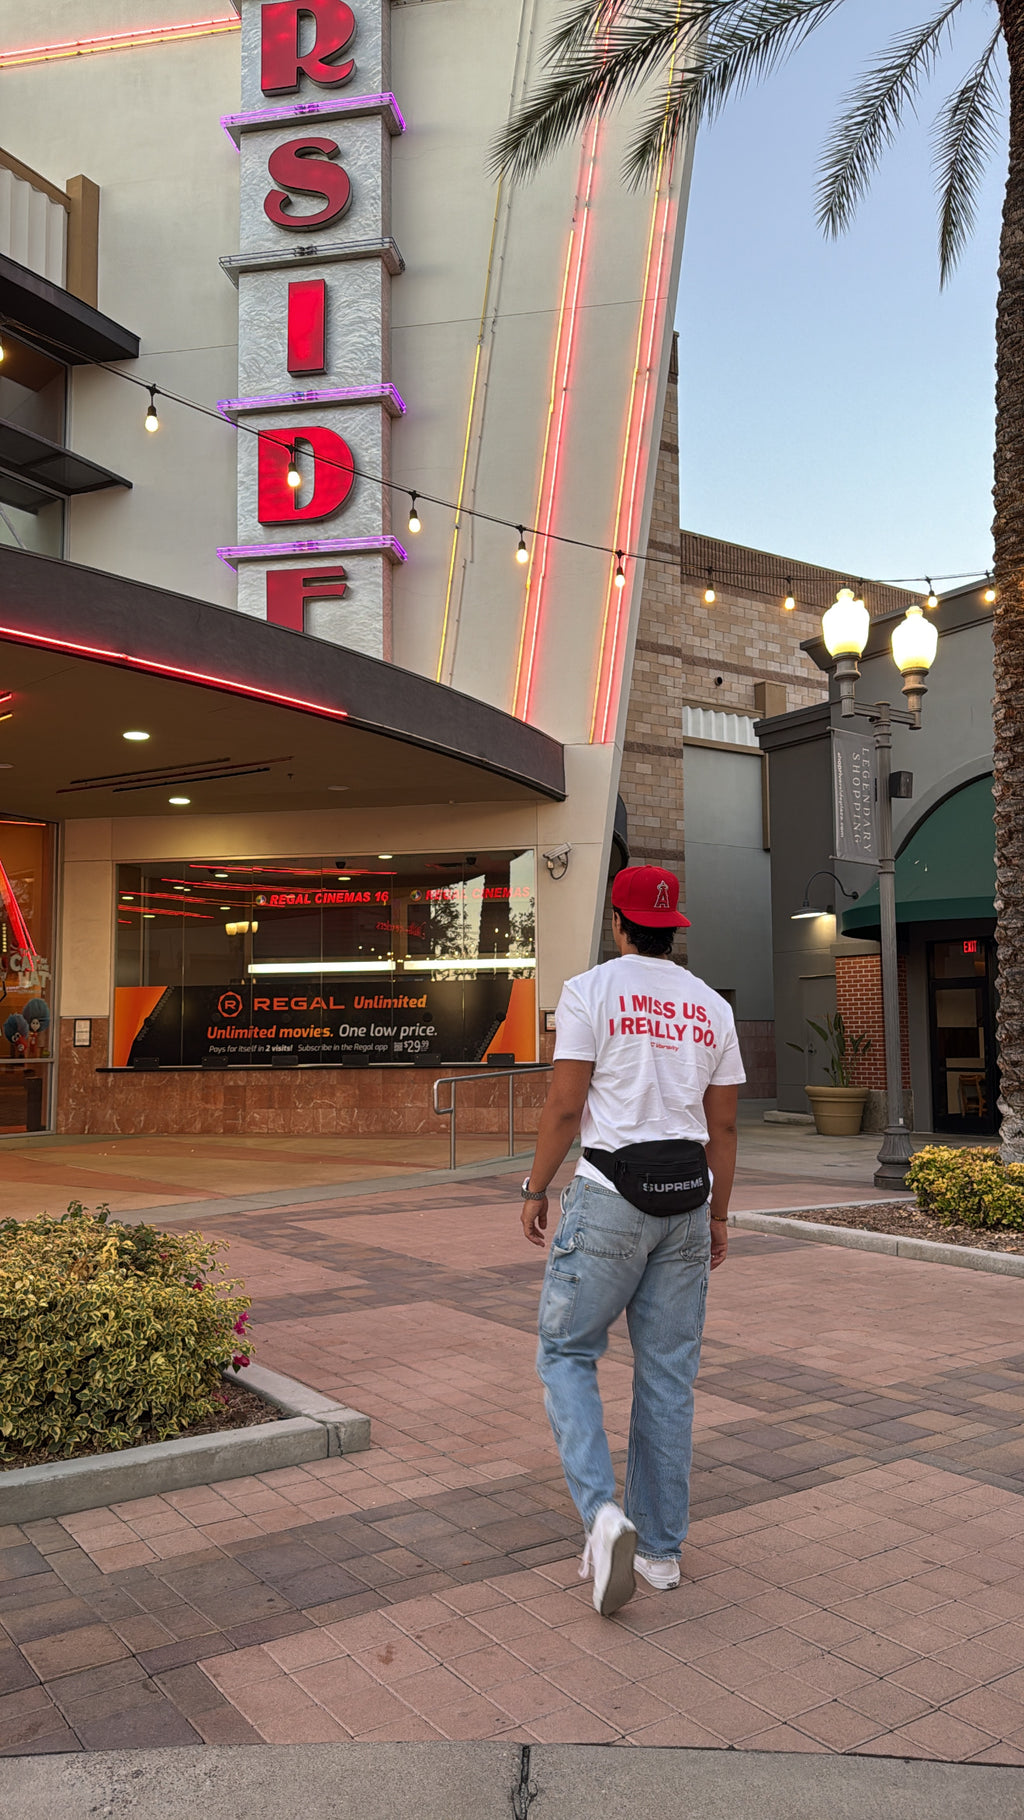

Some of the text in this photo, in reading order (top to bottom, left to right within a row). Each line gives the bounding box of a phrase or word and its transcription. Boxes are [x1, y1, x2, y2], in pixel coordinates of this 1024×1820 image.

[852, 752, 862, 843] SHOPPING
[861, 747, 872, 852] LEGENDARY
[270, 891, 389, 905] REGAL CINEMAS 16
[426, 886, 531, 901] REGAL CINEMAS
[963, 940, 977, 953] EXIT
[253, 996, 345, 1011] REGAL
[354, 994, 427, 1009] Unlimited
[619, 994, 712, 1028] I MISS US,
[207, 1022, 438, 1040] Unlimited movies. One low price.
[609, 1018, 615, 1036] I
[621, 1017, 688, 1042] REALLY
[693, 1025, 717, 1049] DO.
[209, 1043, 389, 1054] Pays for itself in 2 visits! Subscribe in the Regal app
[642, 1177, 704, 1193] SUPREME
